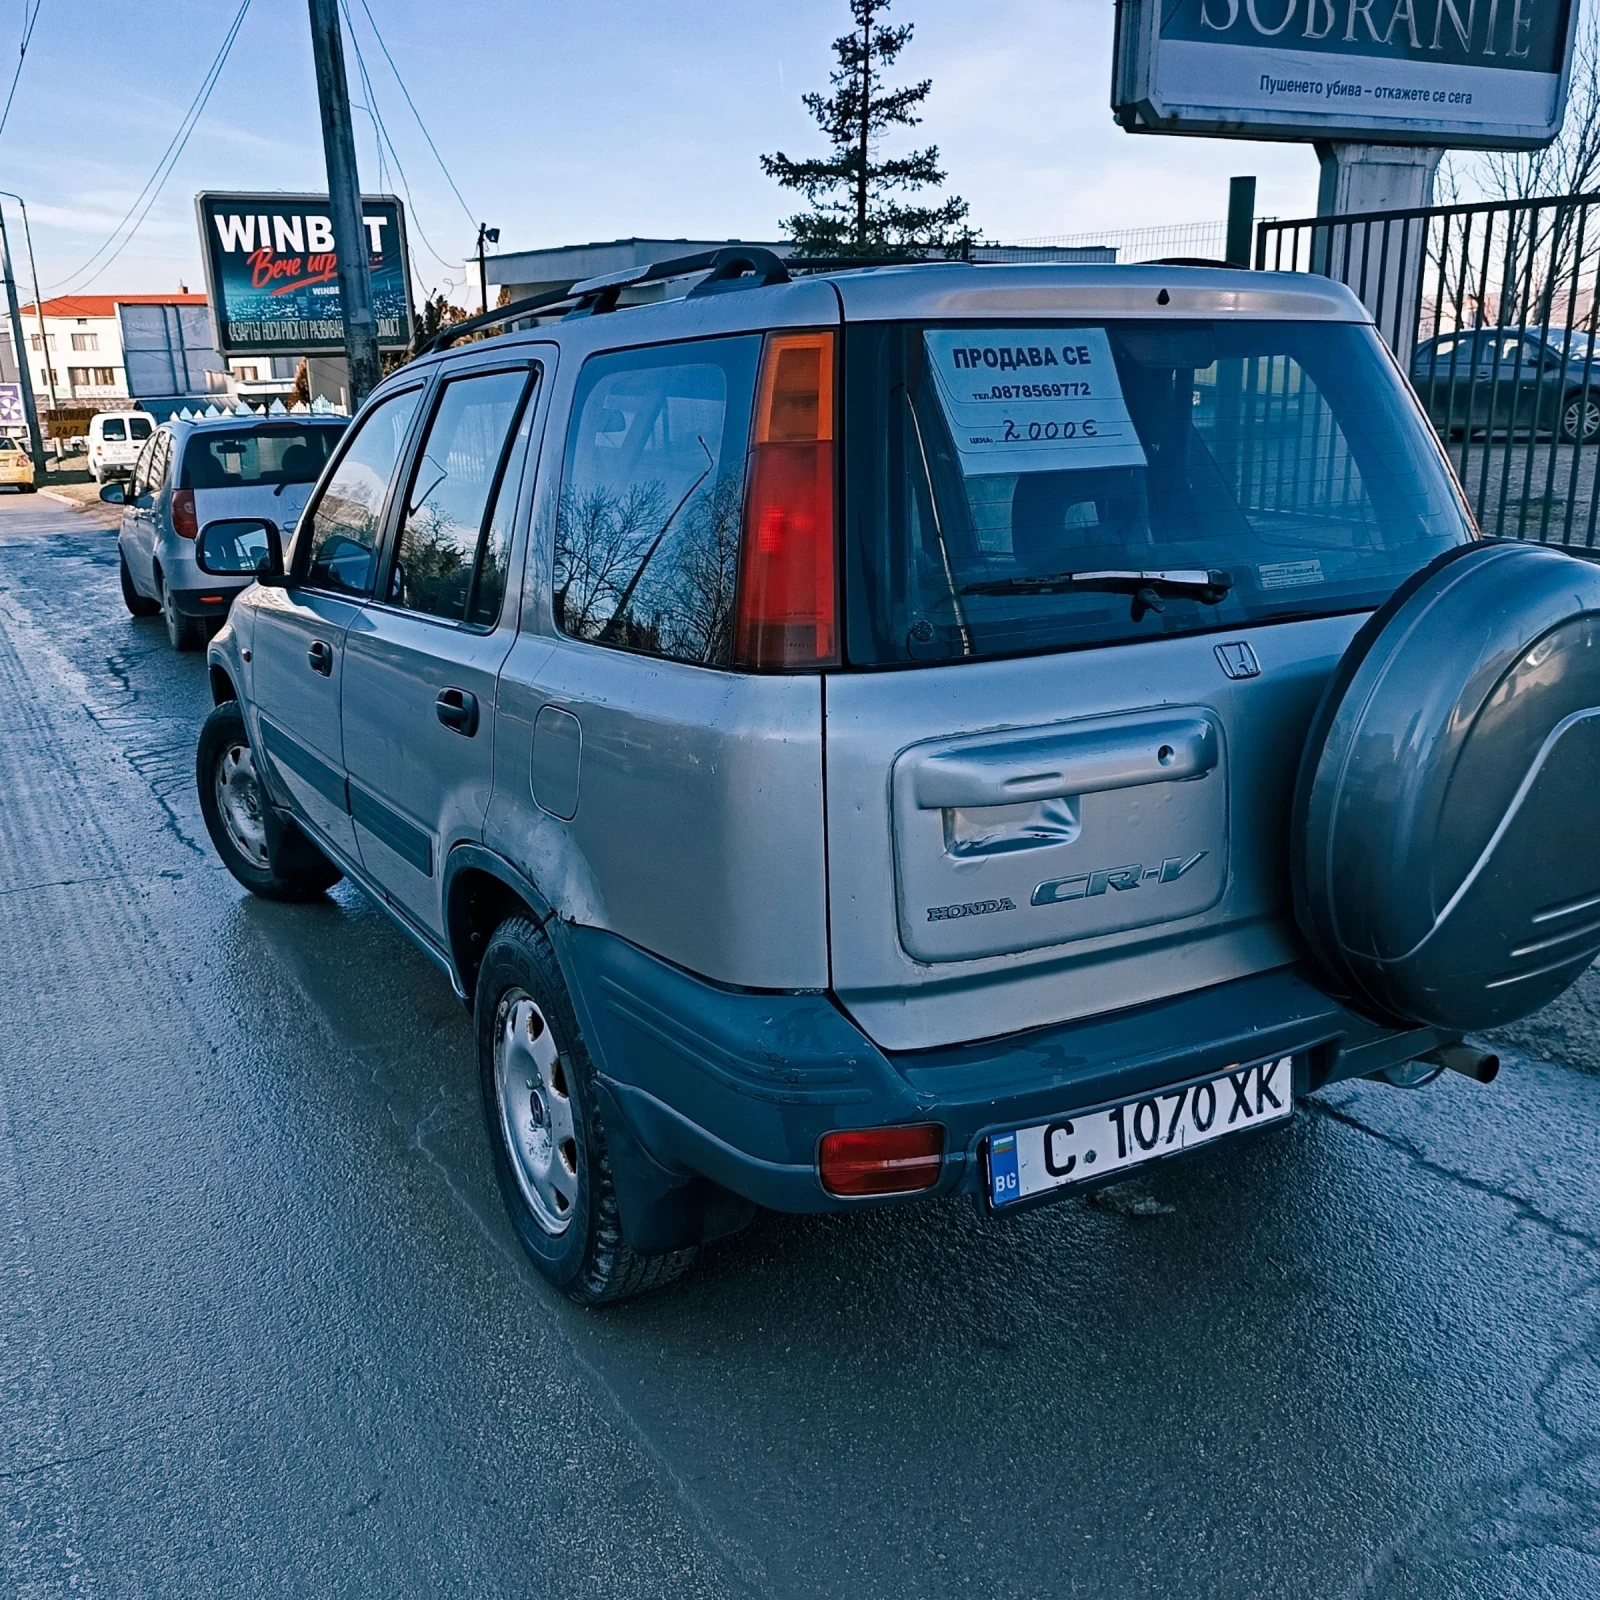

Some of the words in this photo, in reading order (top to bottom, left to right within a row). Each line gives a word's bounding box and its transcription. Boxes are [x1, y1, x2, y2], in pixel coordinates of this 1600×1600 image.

[1259, 75, 1323, 94] Пушенето
[1326, 80, 1361, 98] убива
[1374, 86, 1430, 102] откажете
[1432, 90, 1446, 103] се
[1448, 91, 1472, 104] сега
[213, 214, 388, 253] WINBT
[246, 245, 302, 288] Вече
[312, 286, 340, 295] WINBE
[300, 320, 309, 339] ОТ
[309, 319, 344, 339] РАЗВИВАН
[952, 346, 1058, 371] ПРОДАВА
[1062, 345, 1092, 365] СЕ
[991, 382, 1092, 399] 0878569772
[55, 425, 79, 437] 24/7
[1030, 849, 1211, 907] CR-V
[927, 897, 1017, 922] HONDA
[1109, 1080, 1217, 1160] 1070
[1228, 1056, 1283, 1125] XK
[994, 1171, 1017, 1194] BG
